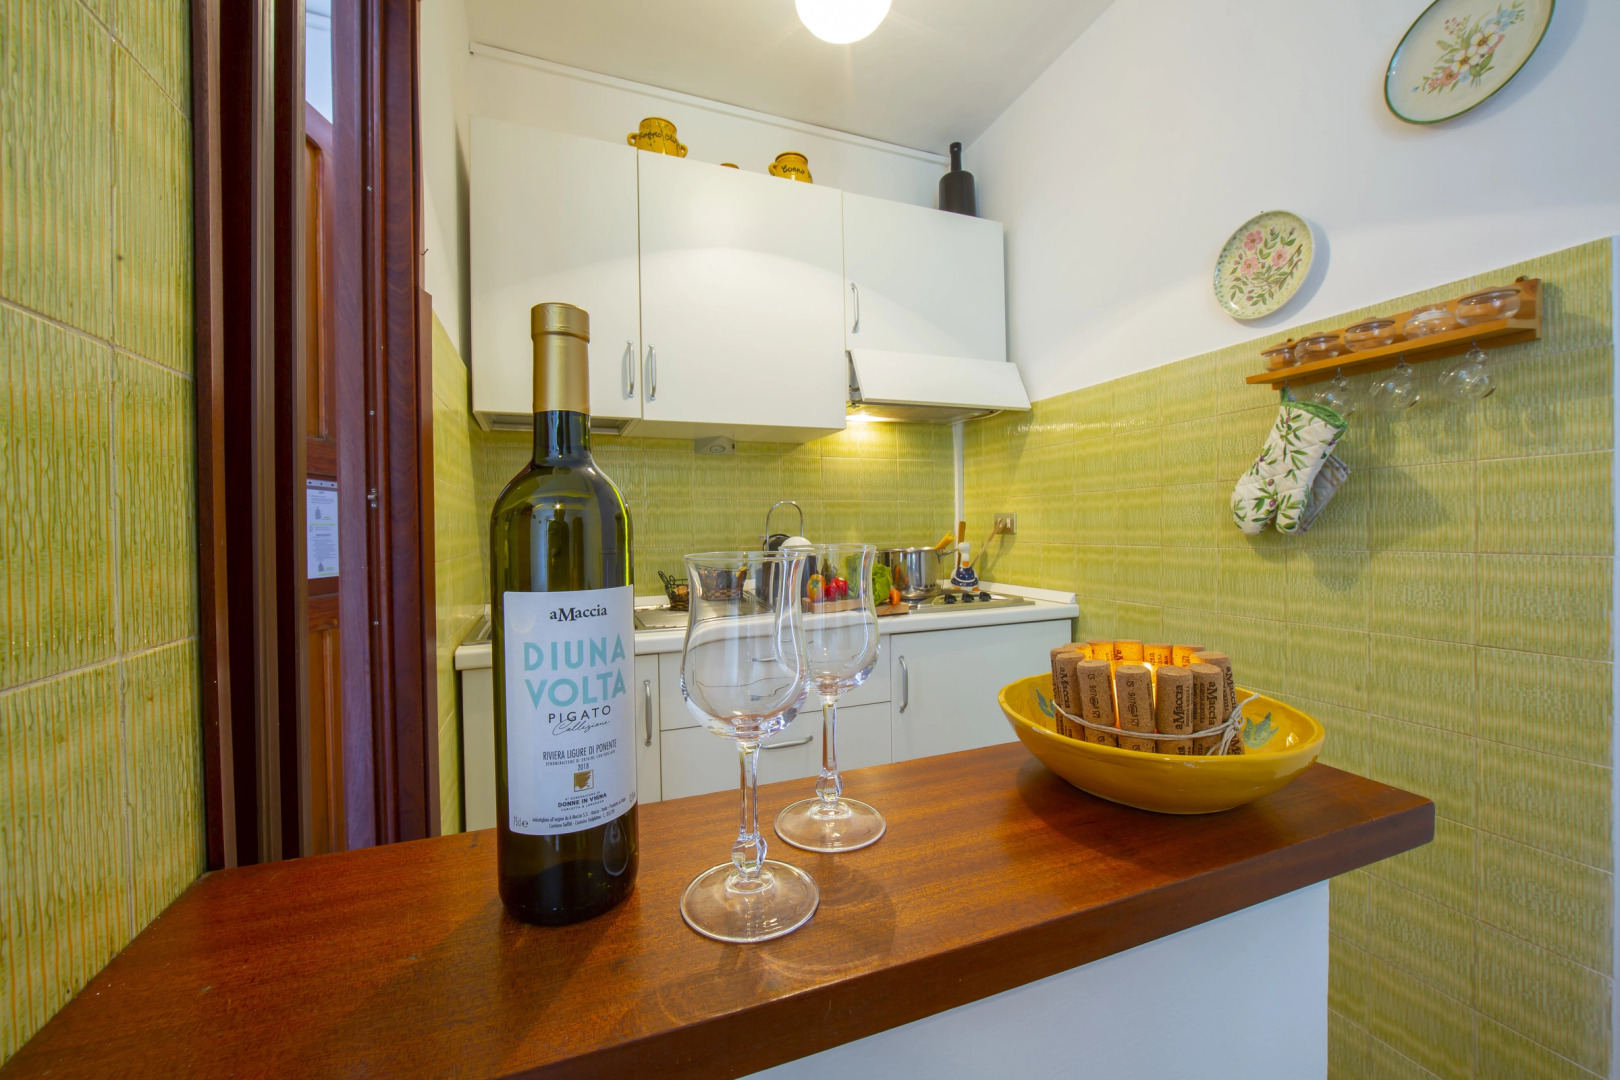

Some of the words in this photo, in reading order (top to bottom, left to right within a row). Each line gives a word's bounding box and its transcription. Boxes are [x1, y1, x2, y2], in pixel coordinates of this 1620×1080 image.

[549, 604, 608, 622] aMaccia
[523, 633, 626, 671] DIUNA
[524, 668, 627, 710] VOLTA
[548, 705, 611, 724] PIGATO
[1173, 684, 1185, 730] aMaccia
[1207, 681, 1218, 726] aMaccia
[542, 750, 566, 761] RIVIERA
[566, 747, 587, 759] LIGURE
[588, 745, 595, 755] DI
[595, 738, 617, 753] PONENTE
[577, 762, 590, 771] 2018
[557, 799, 580, 808] DONNE
[589, 792, 607, 802] VIGNA
